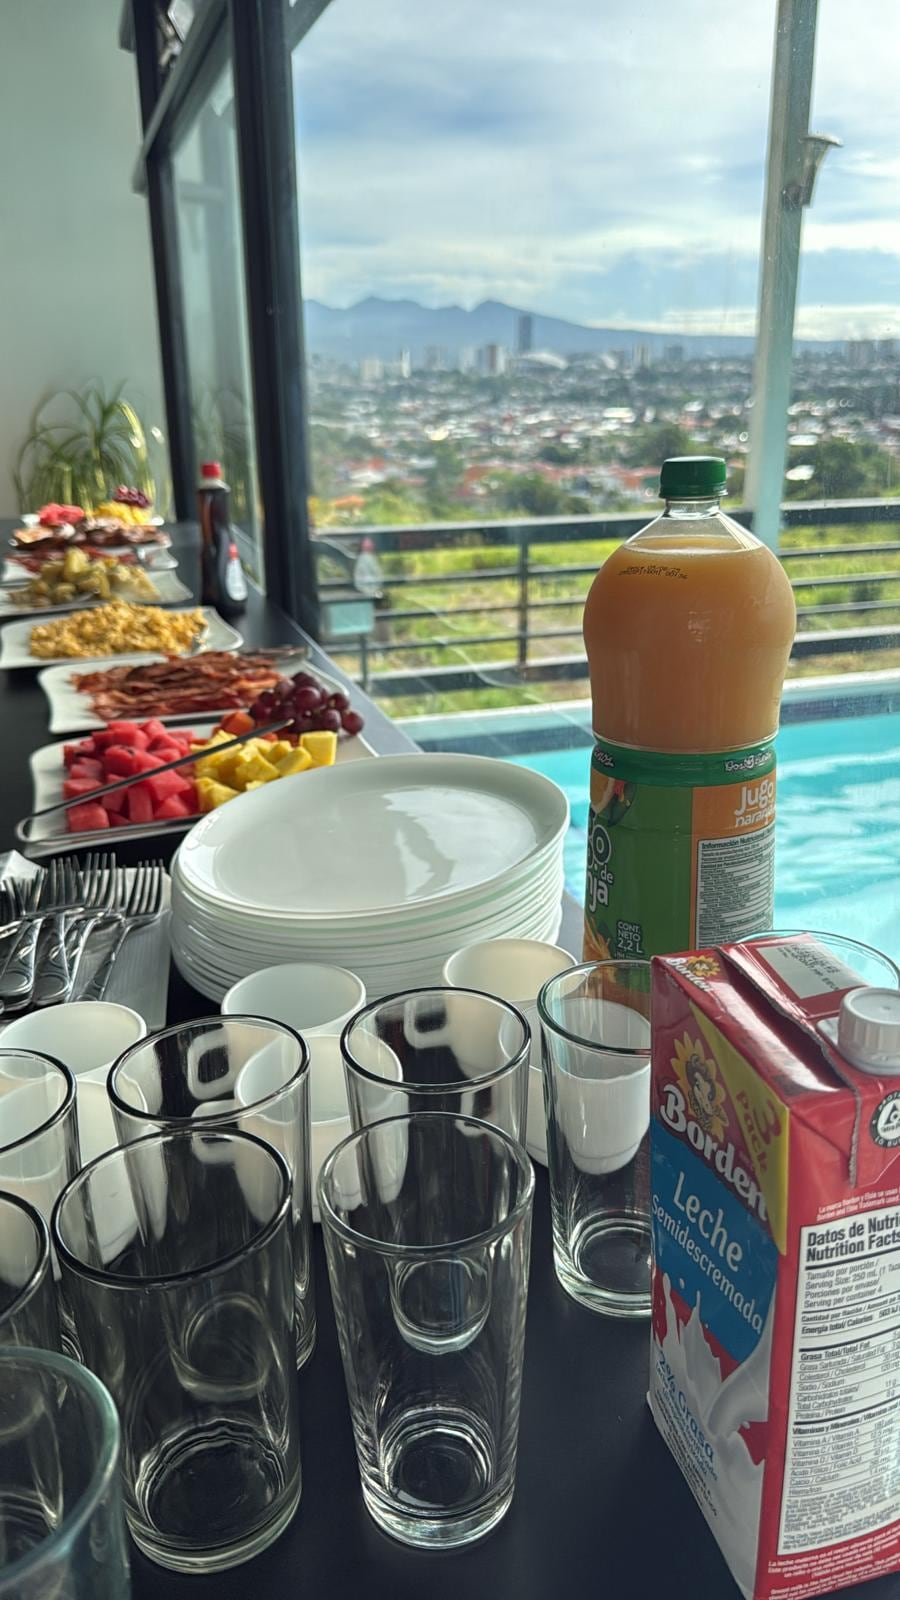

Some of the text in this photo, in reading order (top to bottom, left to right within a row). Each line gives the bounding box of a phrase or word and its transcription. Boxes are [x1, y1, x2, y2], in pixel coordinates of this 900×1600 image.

[734, 780, 774, 816] Jugo
[600, 864, 614, 884] de
[617, 921, 641, 934] CONT.
[617, 929, 641, 942] NETO
[636, 942, 643, 953] L
[665, 957, 715, 992] Borden
[752, 1099, 782, 1145] 3
[660, 1084, 768, 1221] Borden
[674, 1171, 743, 1272] Leche
[807, 1212, 900, 1247] Datos de Nutri
[806, 1239, 864, 1262] Nutrition
[652, 1194, 764, 1334] Semidescremada
[807, 1270, 834, 1280] Tamaño
[836, 1268, 847, 1277] por
[849, 1261, 874, 1274] porción
[805, 1280, 833, 1290] Serving
[852, 1273, 866, 1282] 250
[841, 1286, 853, 1295] por
[804, 1298, 831, 1309] Serving
[833, 1296, 845, 1306] per
[678, 1391, 714, 1462] Grasa
